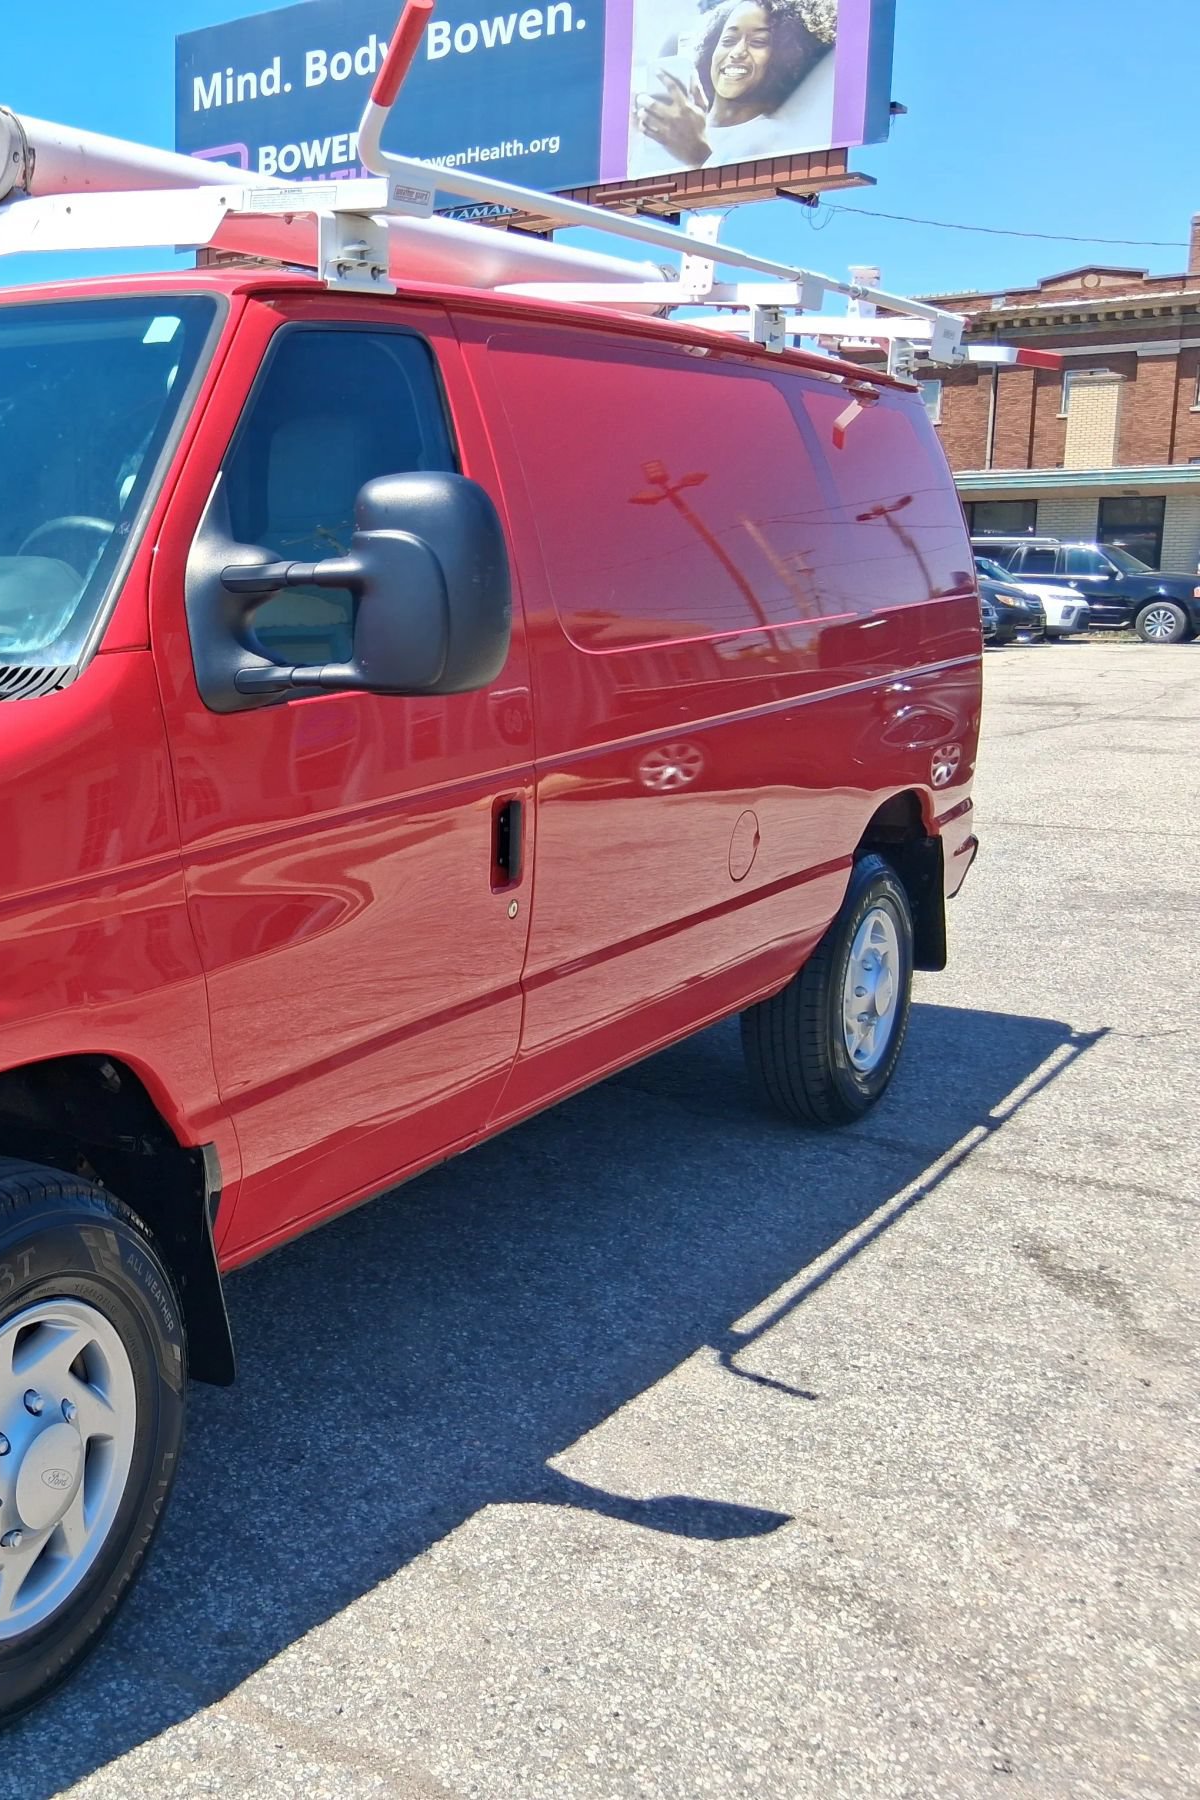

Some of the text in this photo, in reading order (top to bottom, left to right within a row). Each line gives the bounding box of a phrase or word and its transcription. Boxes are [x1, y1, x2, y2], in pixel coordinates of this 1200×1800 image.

[193, 56, 292, 112] Mind.
[427, 1, 586, 61] Bowen.
[126, 1253, 175, 1334] ALL WEATHER
